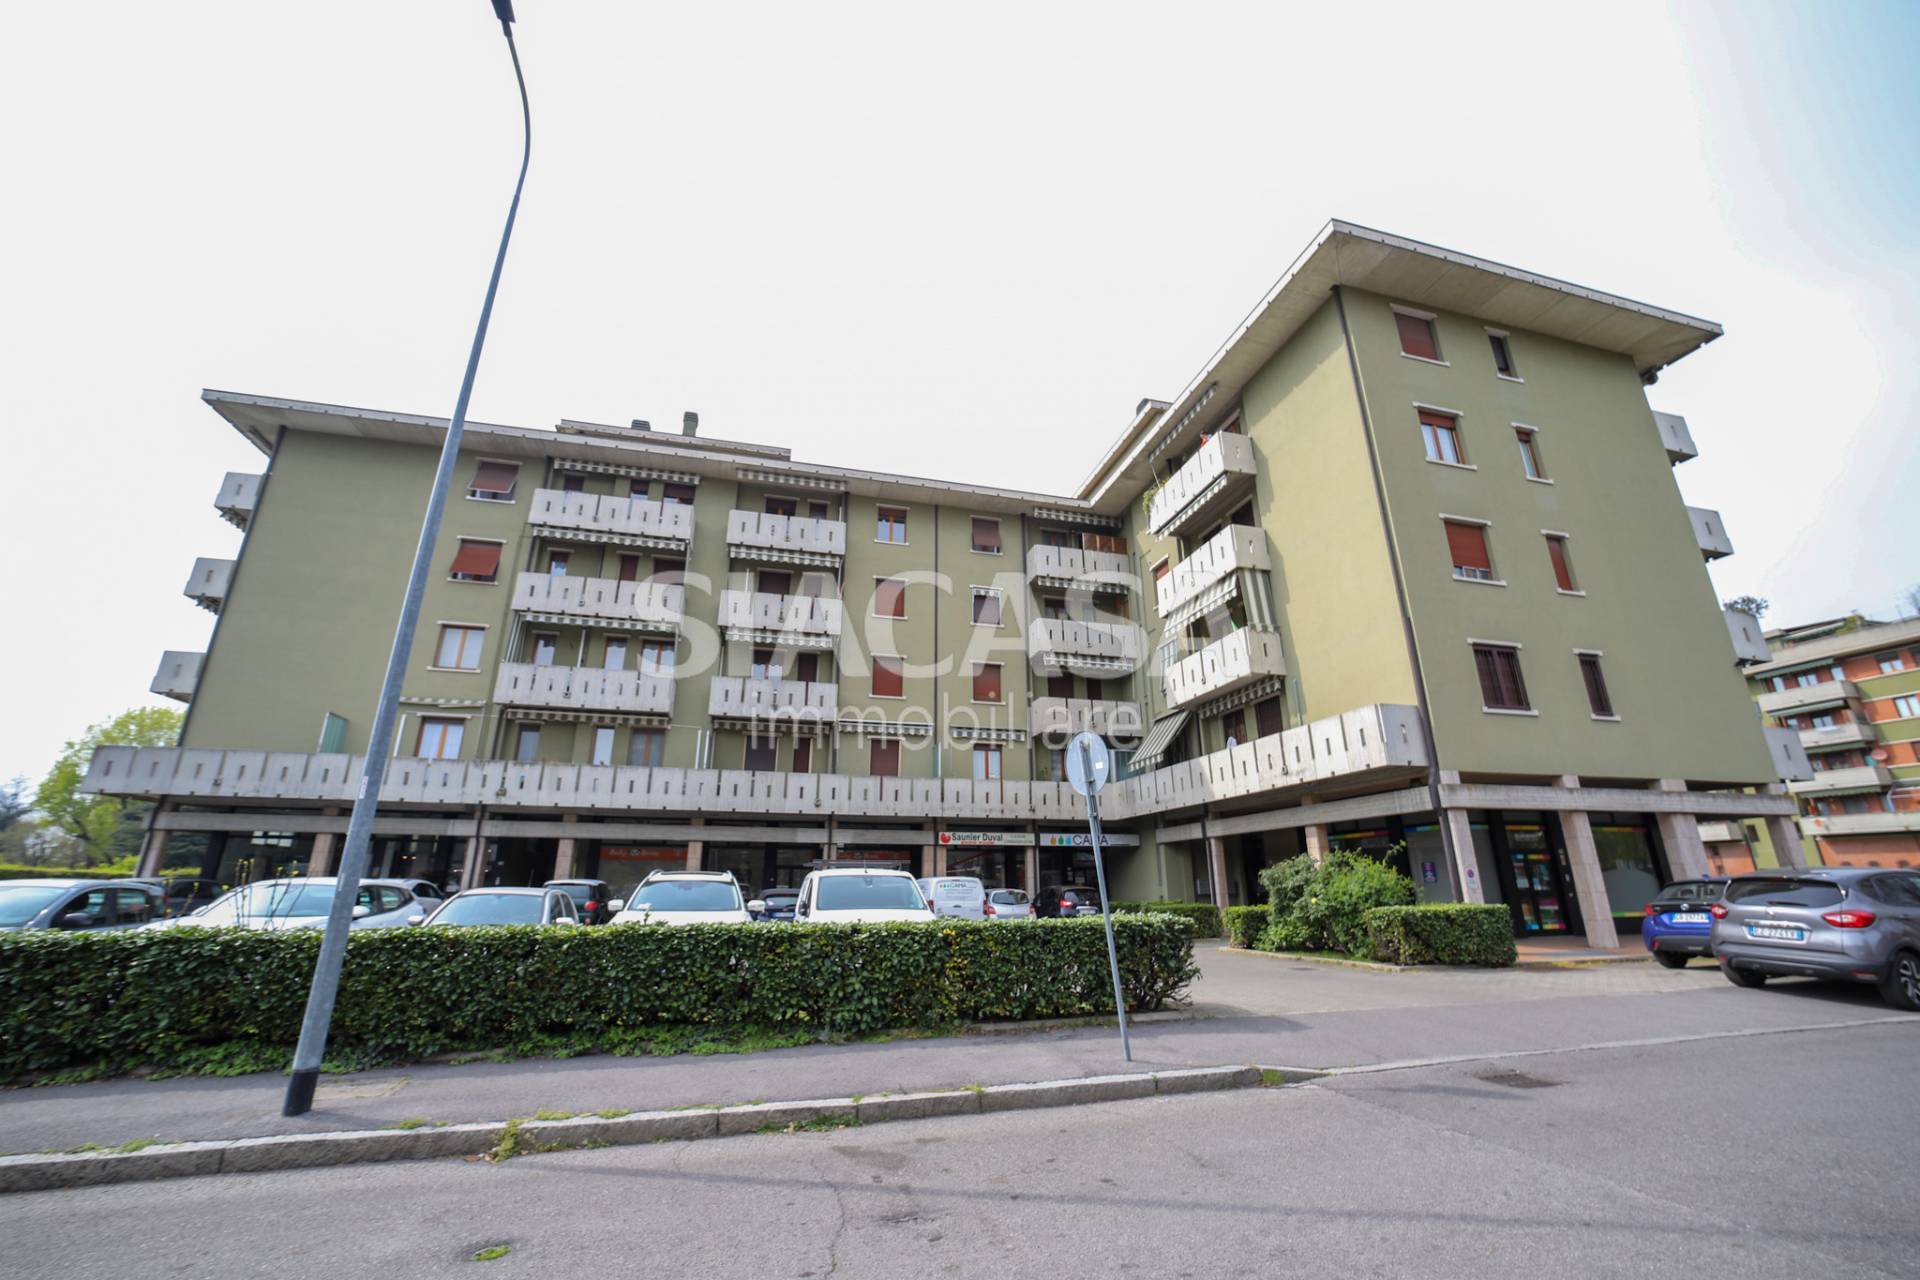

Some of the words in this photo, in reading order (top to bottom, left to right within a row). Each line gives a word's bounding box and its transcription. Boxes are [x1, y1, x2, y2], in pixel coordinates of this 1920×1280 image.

[952, 832, 980, 841] Saunier
[982, 832, 1003, 841] Duval
[1072, 834, 1109, 845] CAA
